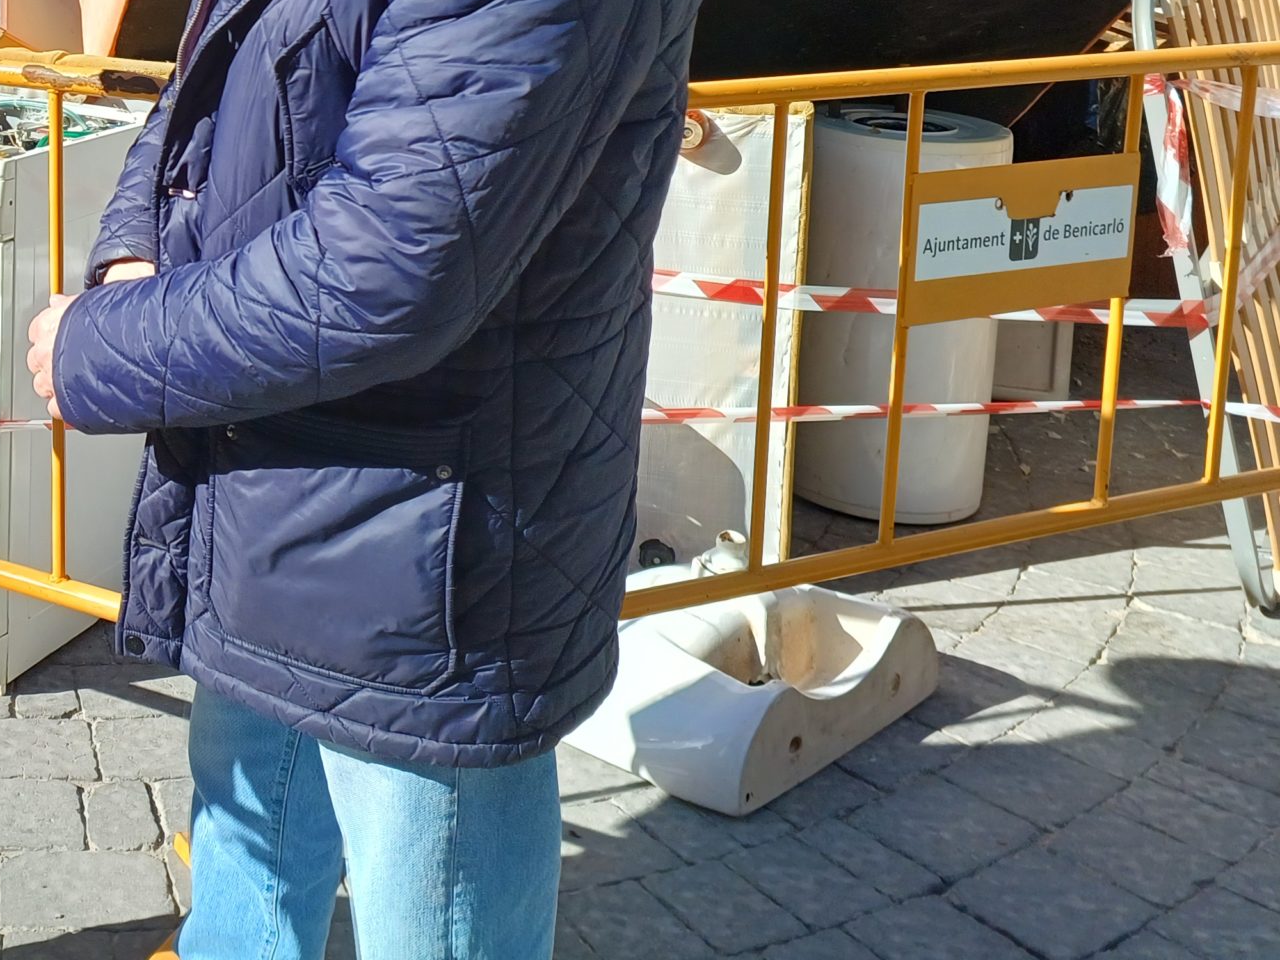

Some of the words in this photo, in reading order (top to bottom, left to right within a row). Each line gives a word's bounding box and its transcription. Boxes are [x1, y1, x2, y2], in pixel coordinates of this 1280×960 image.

[923, 231, 1006, 258] Ajuntament
[1043, 225, 1060, 242] de
[1063, 217, 1125, 240] Benicarló
